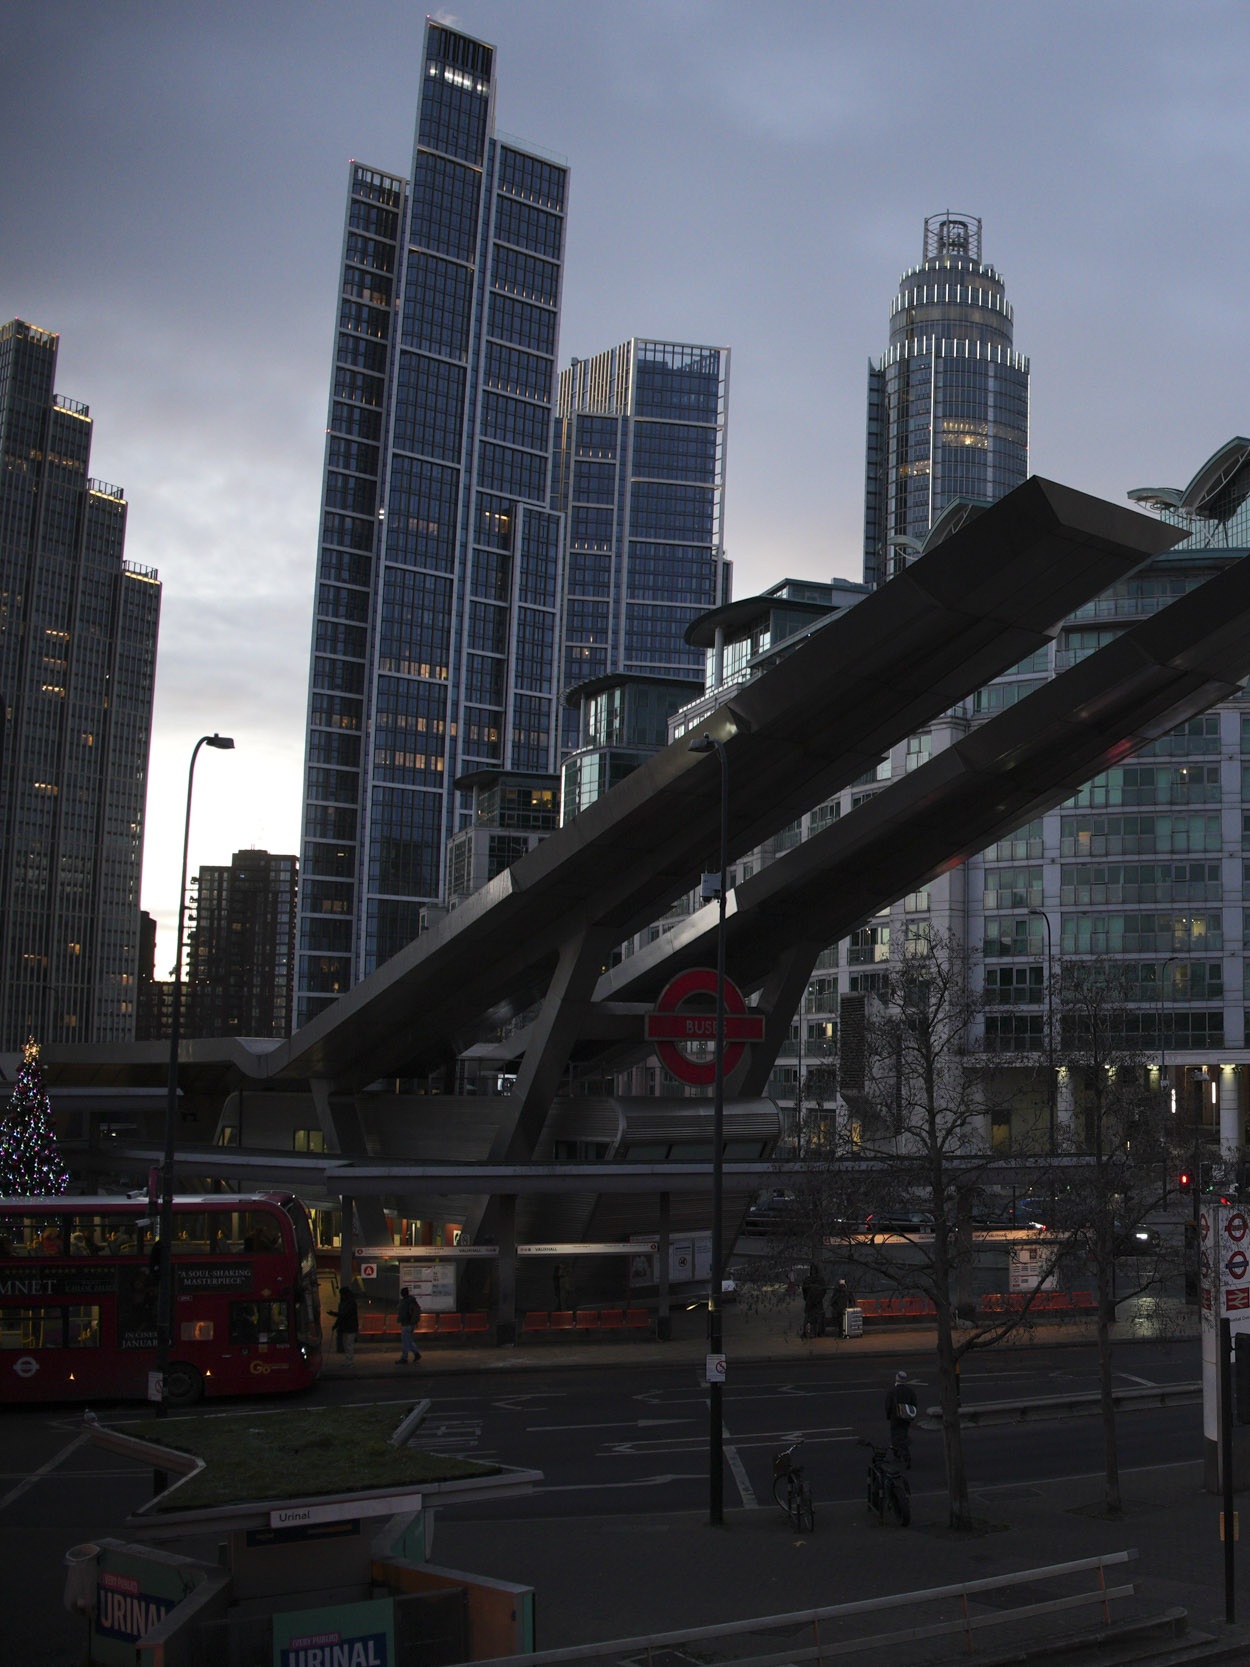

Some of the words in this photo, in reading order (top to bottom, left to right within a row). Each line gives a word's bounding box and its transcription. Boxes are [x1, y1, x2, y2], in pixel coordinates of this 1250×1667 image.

[188, 1269, 251, 1278] SOUL-SHAKING
[184, 1277, 246, 1286] MASTERPIECE"
[279, 1510, 311, 1522] Urinal
[288, 1640, 381, 1667] URINAL
